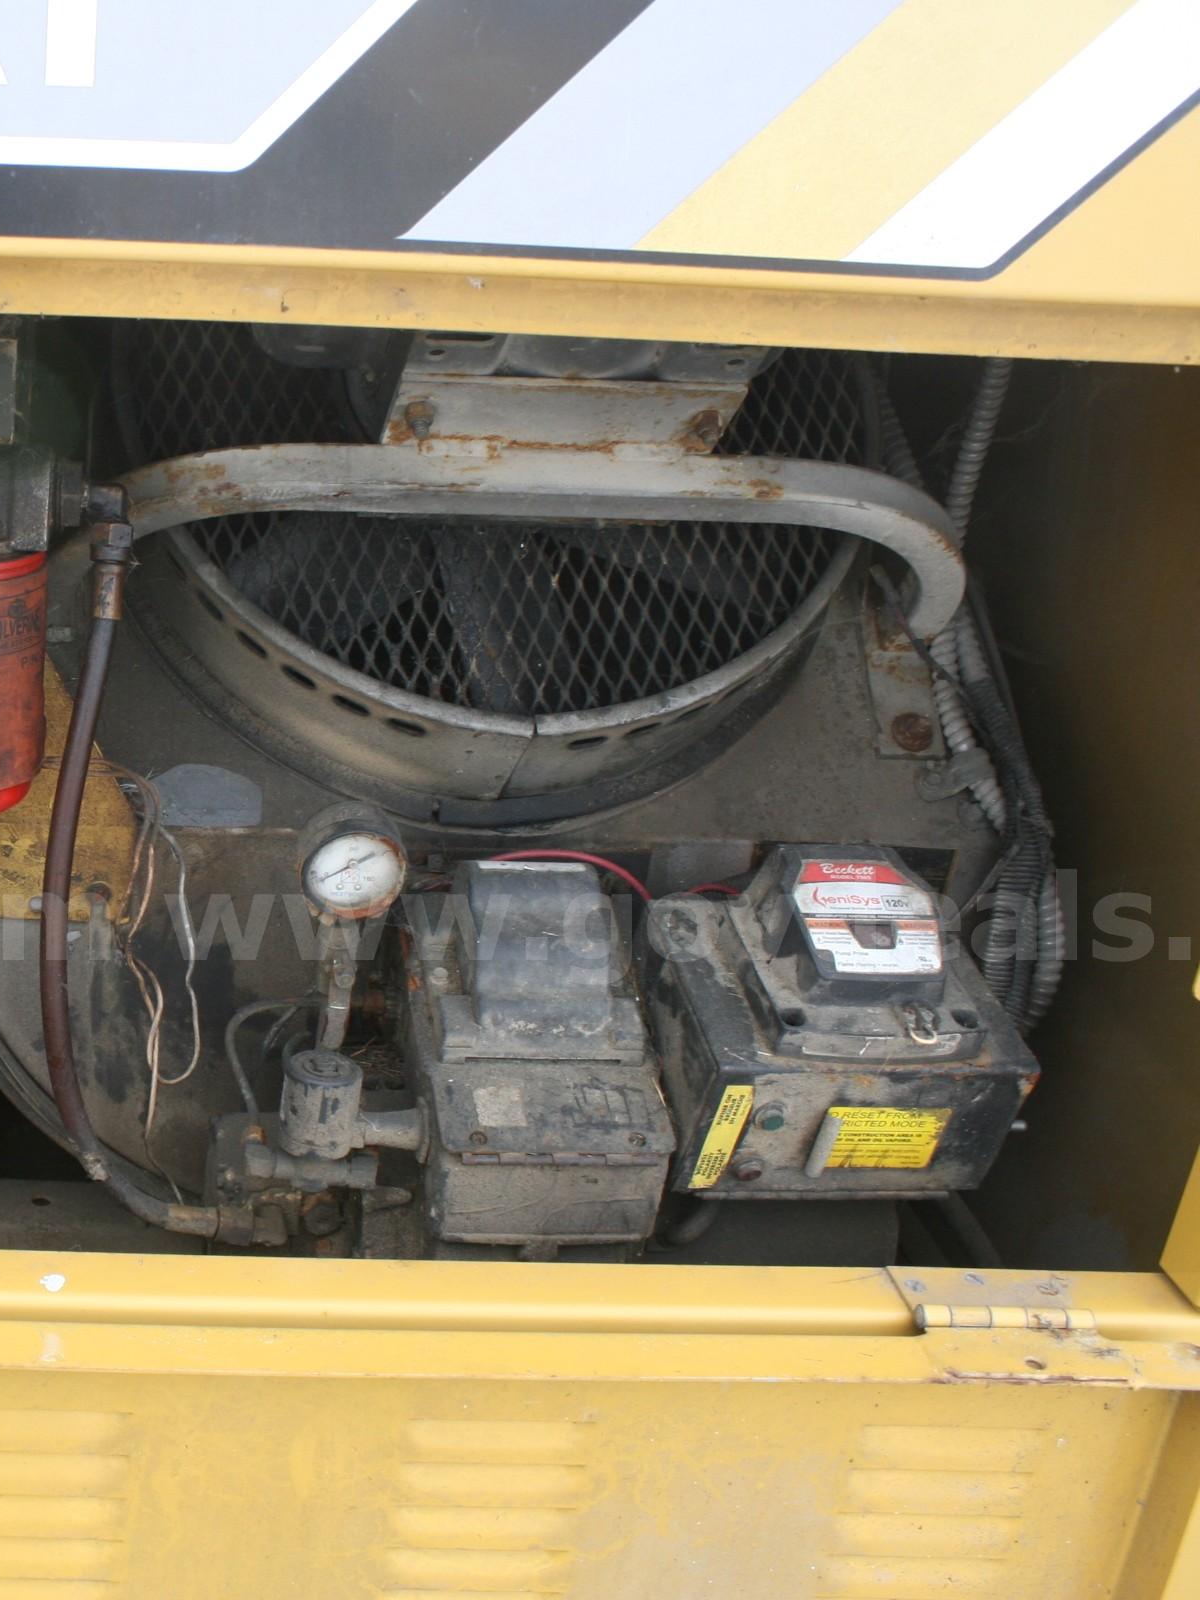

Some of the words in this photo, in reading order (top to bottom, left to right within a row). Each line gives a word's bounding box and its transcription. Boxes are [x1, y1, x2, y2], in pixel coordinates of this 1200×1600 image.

[819, 862, 875, 875] Beckett
[812, 886, 881, 908] GeniSys
[841, 1111, 882, 1119] RESET
[885, 1112, 923, 1120] FROM
[842, 1120, 888, 1128] RICTED
[890, 1120, 927, 1128] MODE
